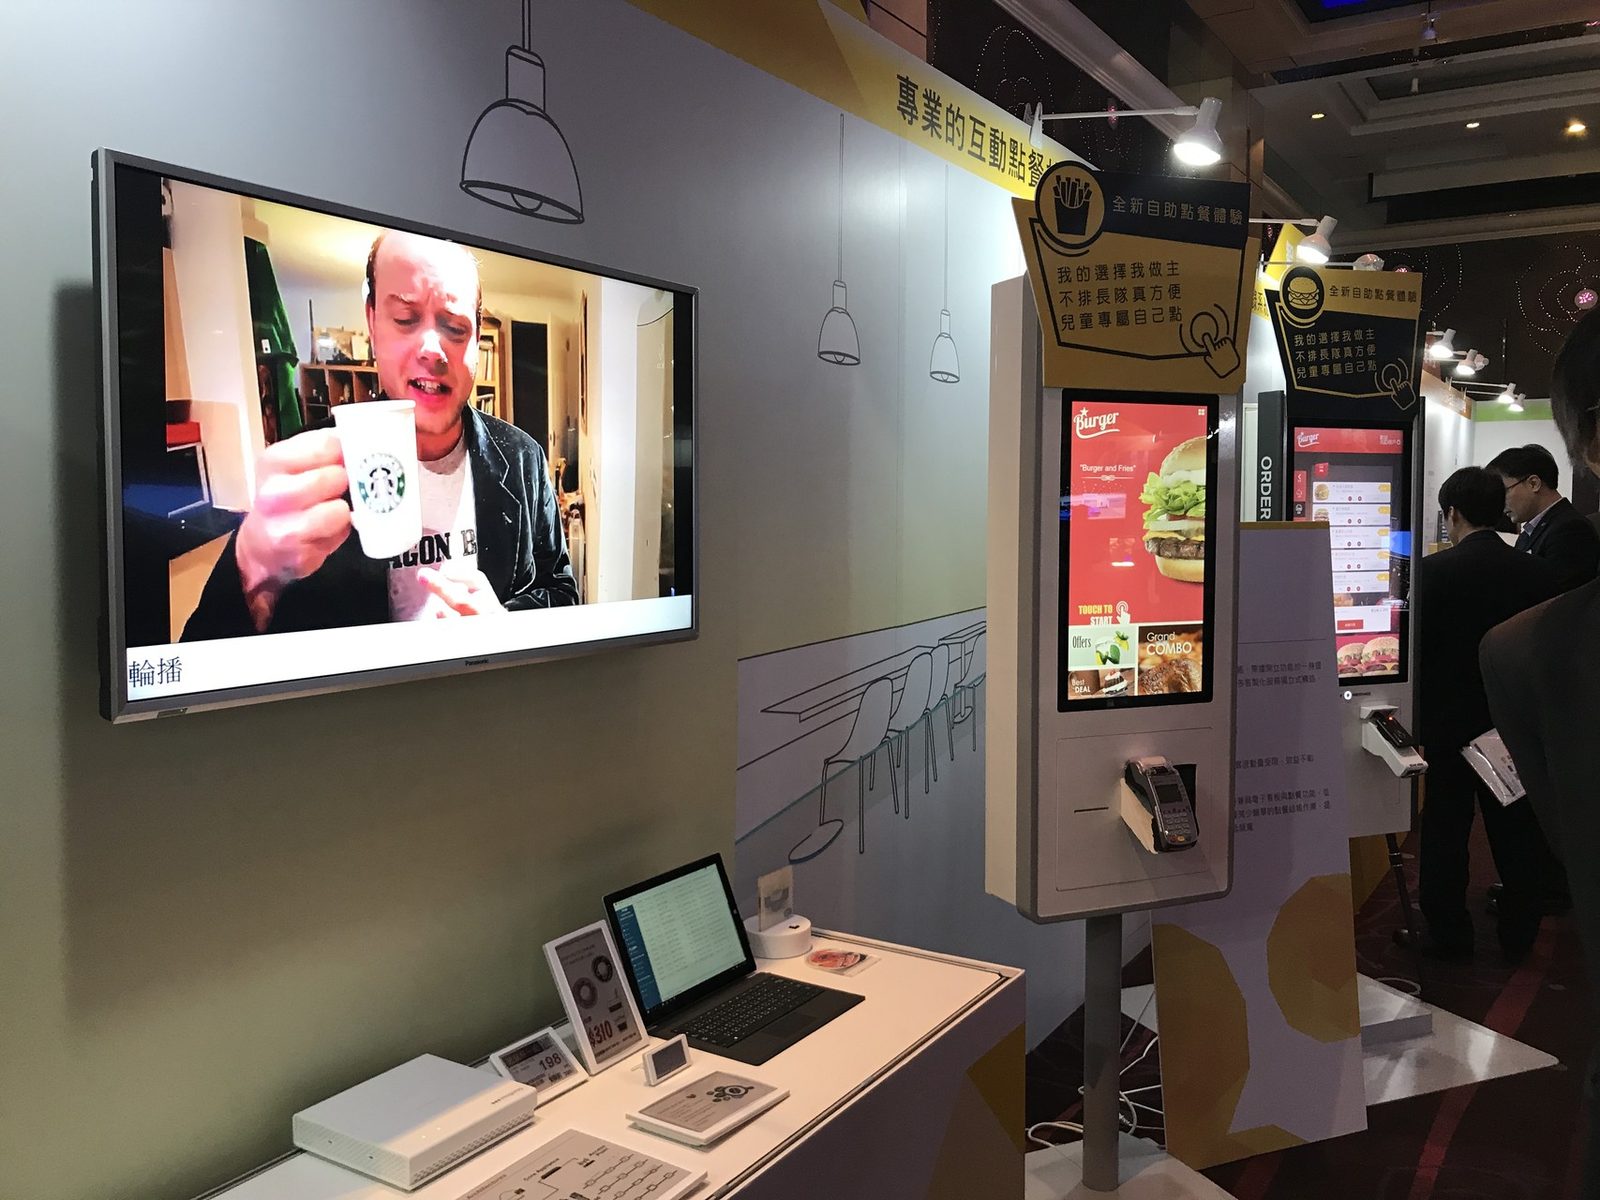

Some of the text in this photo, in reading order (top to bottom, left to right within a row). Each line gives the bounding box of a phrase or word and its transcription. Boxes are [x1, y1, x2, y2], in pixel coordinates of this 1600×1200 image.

[896, 73, 1052, 188] 專業的互動點餐
[1112, 195, 1244, 225] 全新自助點餐體驗
[1057, 259, 1180, 284] 我的選擇我做主
[1059, 283, 1182, 307] 不排長隊真方便
[1061, 306, 1182, 331] 兒童專屬自己點
[1073, 411, 1120, 438] Burger
[1260, 456, 1273, 520] ORDER
[1078, 604, 1113, 615] TOUCH TO
[1090, 615, 1113, 625] START
[1072, 635, 1092, 649] Offers
[1146, 631, 1175, 642] Grand
[1146, 641, 1192, 655] COMBO
[128, 656, 183, 688] 輪播
[539, 1052, 562, 1071] 198
